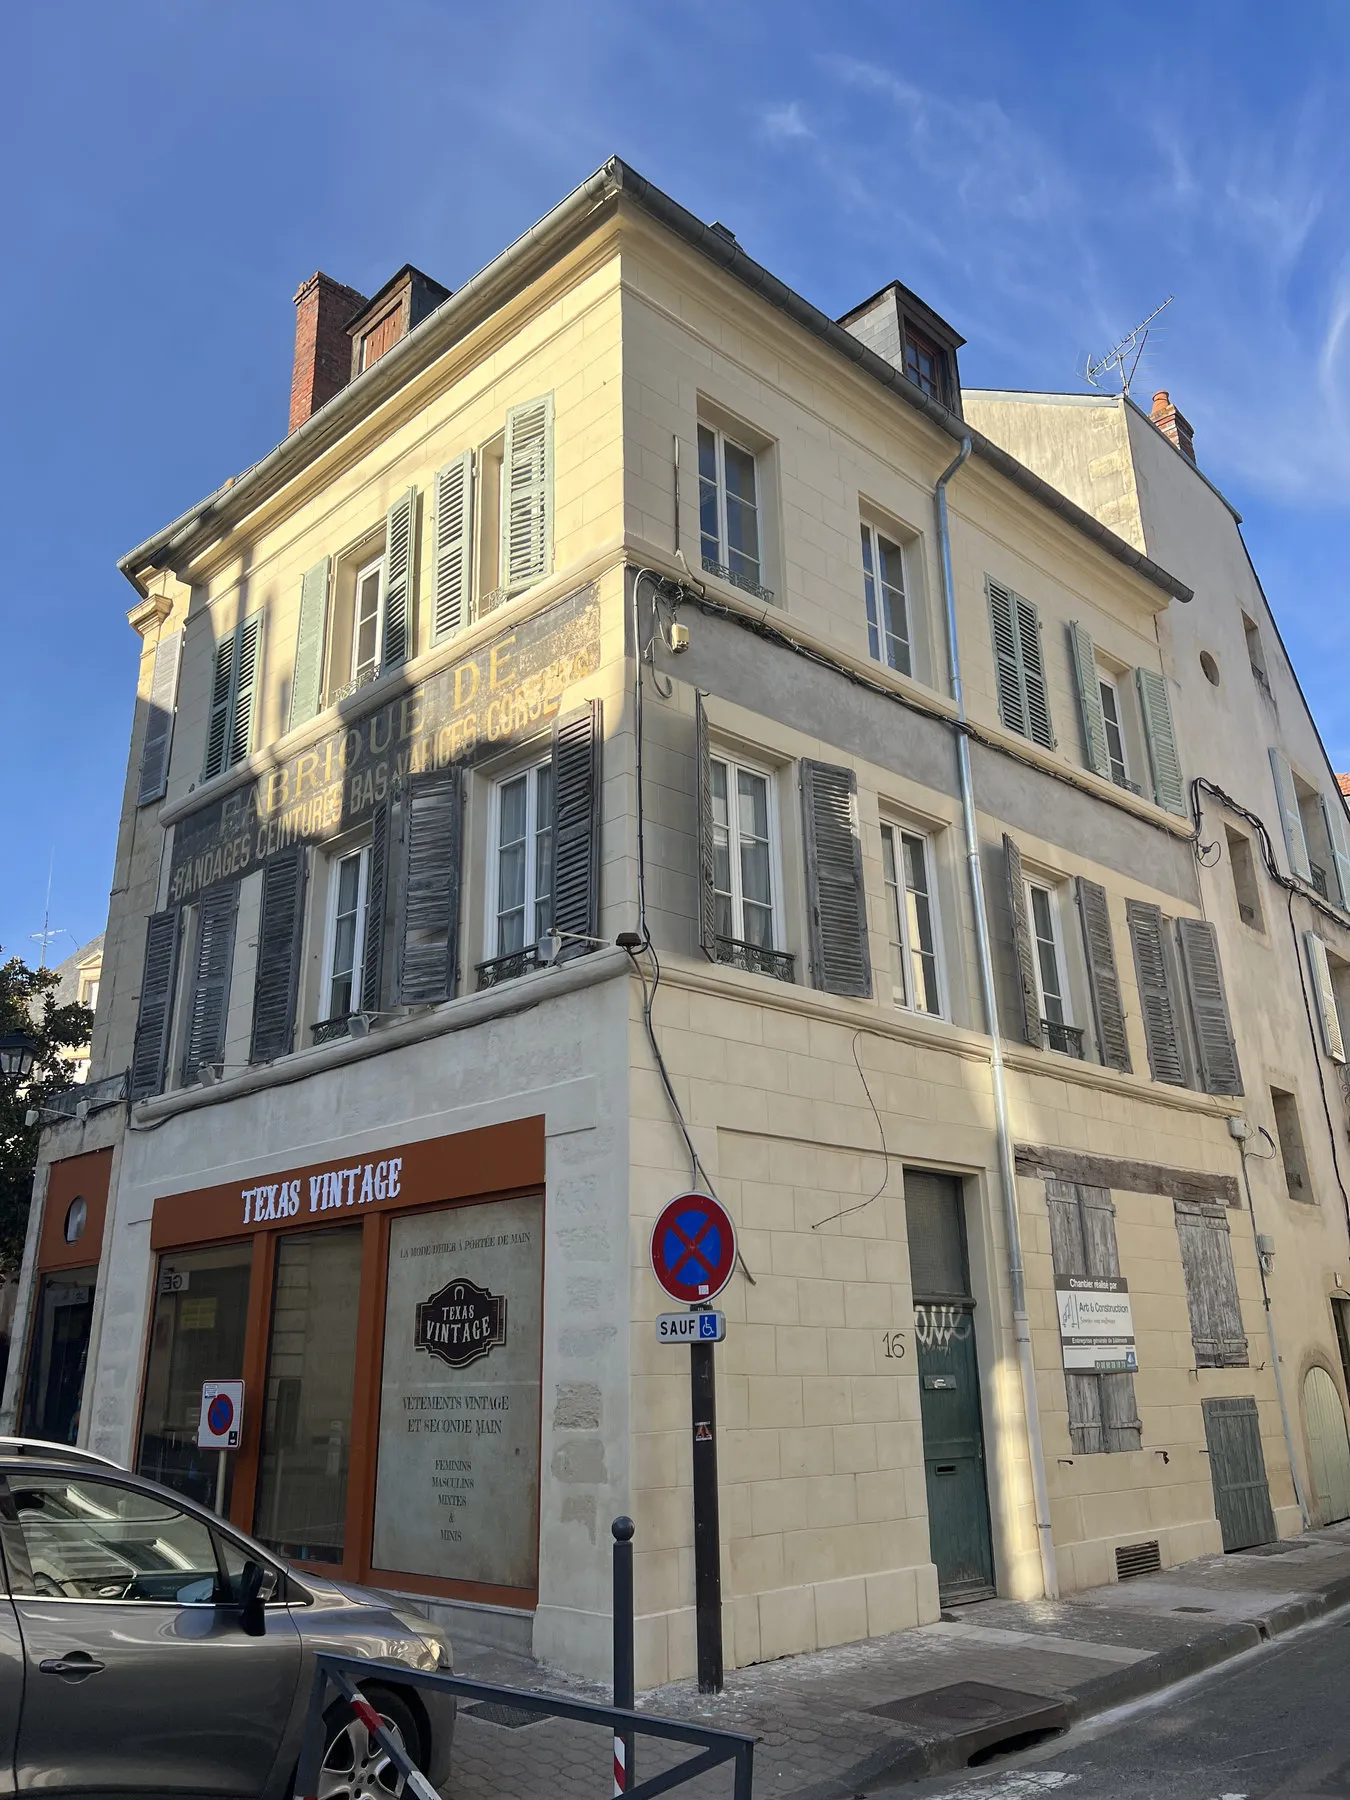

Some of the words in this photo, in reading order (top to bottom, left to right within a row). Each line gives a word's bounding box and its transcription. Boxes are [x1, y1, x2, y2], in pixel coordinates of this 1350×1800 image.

[453, 634, 517, 712] DE
[174, 832, 251, 901] BANDAGES
[255, 779, 344, 860] CEINTURES
[350, 761, 388, 815] BAS
[241, 1179, 302, 1224] TEXAS
[308, 1157, 403, 1214] VINTAGE
[400, 1247, 409, 1259] LA
[411, 1244, 431, 1257] MODE
[464, 1235, 495, 1251] PORTÉE
[497, 1234, 509, 1246] DE
[511, 1231, 531, 1244] MAIN
[1069, 1278, 1093, 1289] Chantier
[1109, 1282, 1117, 1291] par
[441, 1304, 475, 1321] TEXAS
[1079, 1302, 1090, 1313] Art
[1095, 1302, 1129, 1314] Construction
[426, 1315, 491, 1344] VINTAGE
[660, 1319, 696, 1336] SAUF
[882, 1331, 906, 1359] 16
[464, 1395, 509, 1411] VINTAGE
[408, 1418, 421, 1433] ET
[424, 1418, 472, 1434] SECONDE
[476, 1419, 502, 1434] MAIN
[431, 1476, 475, 1489] MASCULINS
[438, 1494, 467, 1507] MIXTES
[448, 1512, 454, 1523] &
[440, 1529, 462, 1542] MINIS
